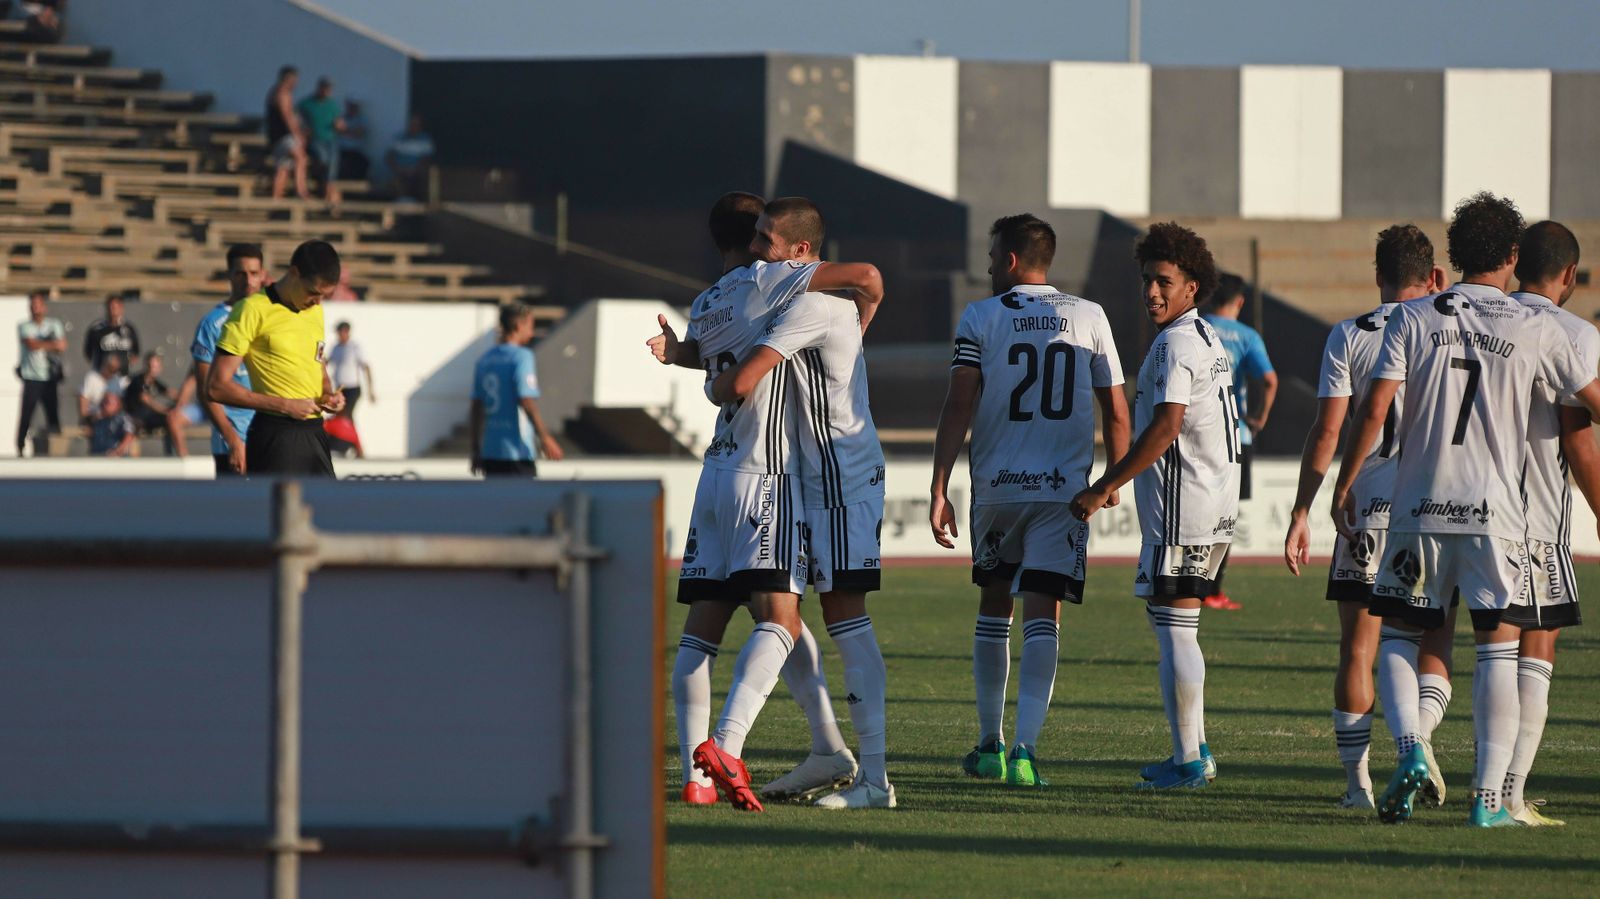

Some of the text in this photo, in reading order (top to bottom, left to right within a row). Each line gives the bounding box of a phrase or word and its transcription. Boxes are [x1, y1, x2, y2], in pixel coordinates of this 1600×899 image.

[1013, 316, 1069, 333] CARLOS D.
[1465, 330, 1515, 359] ARAUJO
[1008, 342, 1076, 421] 20
[1450, 357, 1482, 446] 7
[991, 470, 1043, 487] Jimbee
[757, 473, 774, 560] inmohogares
[1411, 498, 1470, 517] Jimbee
[1447, 516, 1469, 525] melon
[1170, 565, 1210, 578] aroca
